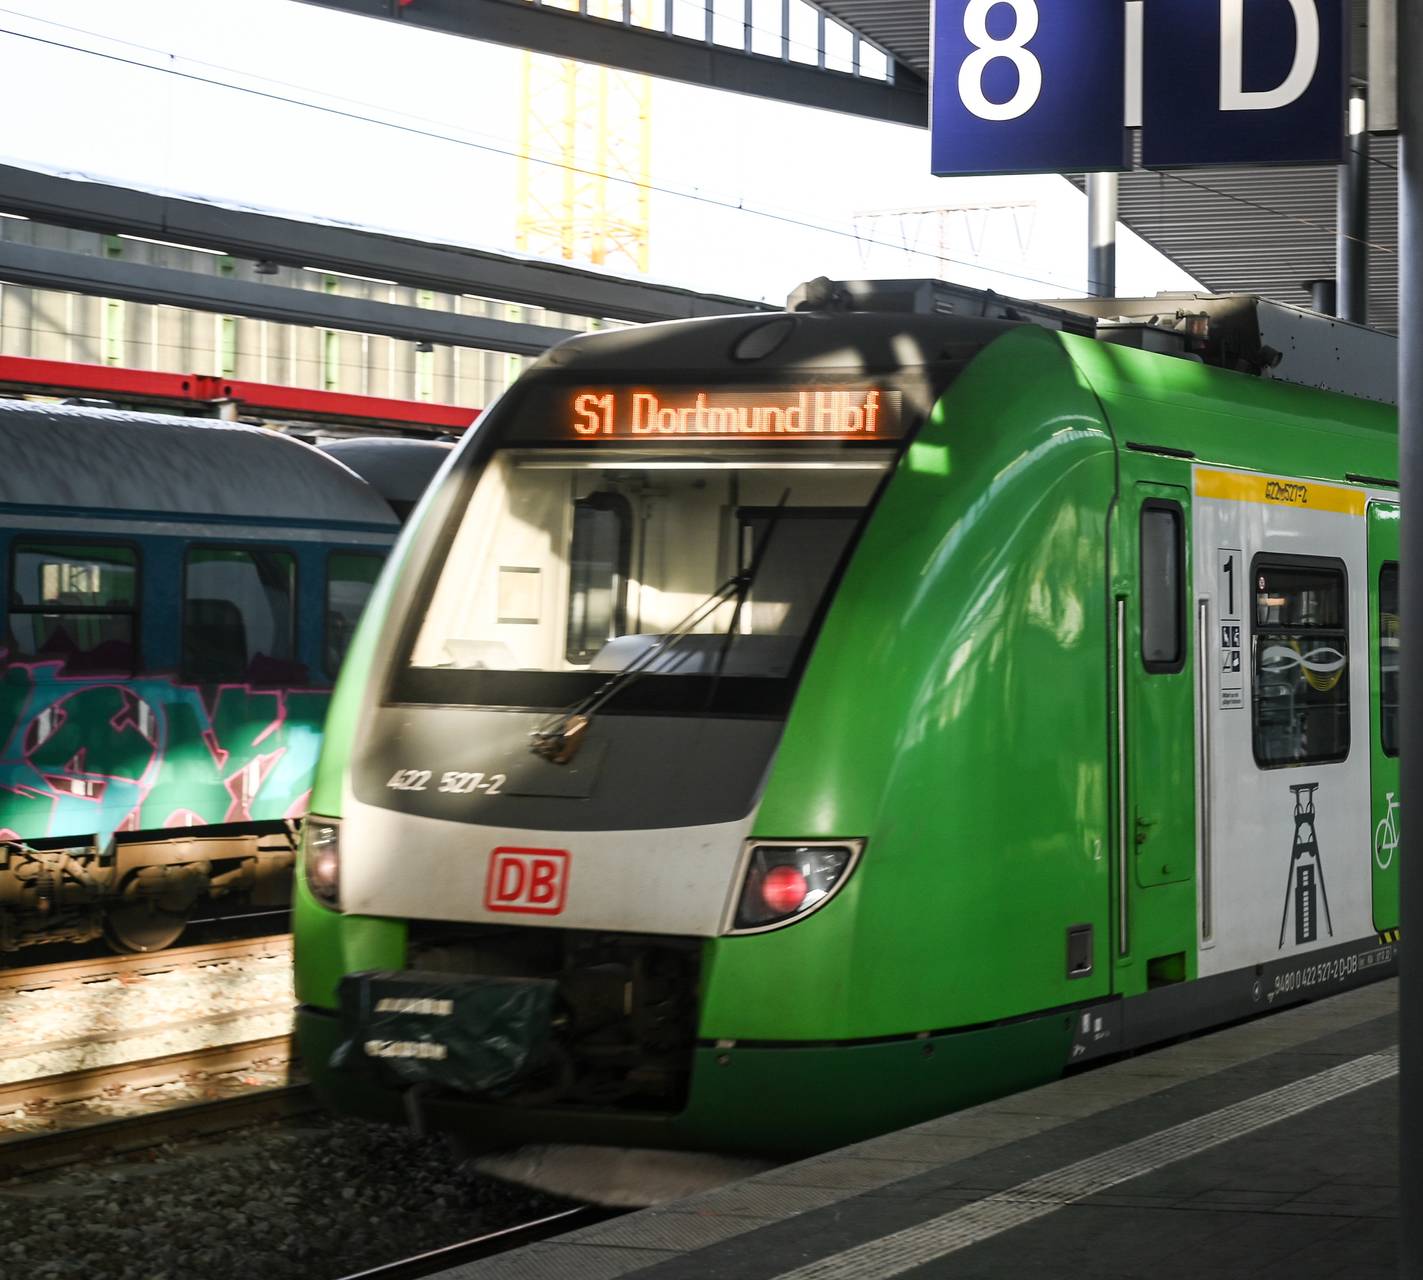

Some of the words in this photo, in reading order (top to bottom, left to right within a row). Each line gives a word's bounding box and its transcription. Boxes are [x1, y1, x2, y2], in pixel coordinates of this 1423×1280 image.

[957, 0, 1043, 121] 8
[1219, 0, 1320, 111] D
[574, 393, 614, 434] S1
[631, 392, 806, 433] Dortmund
[814, 390, 880, 432] Hbf
[1223, 555, 1233, 615] 1
[386, 769, 432, 791] 422
[437, 771, 507, 795] 527-2
[496, 857, 558, 904] DB
